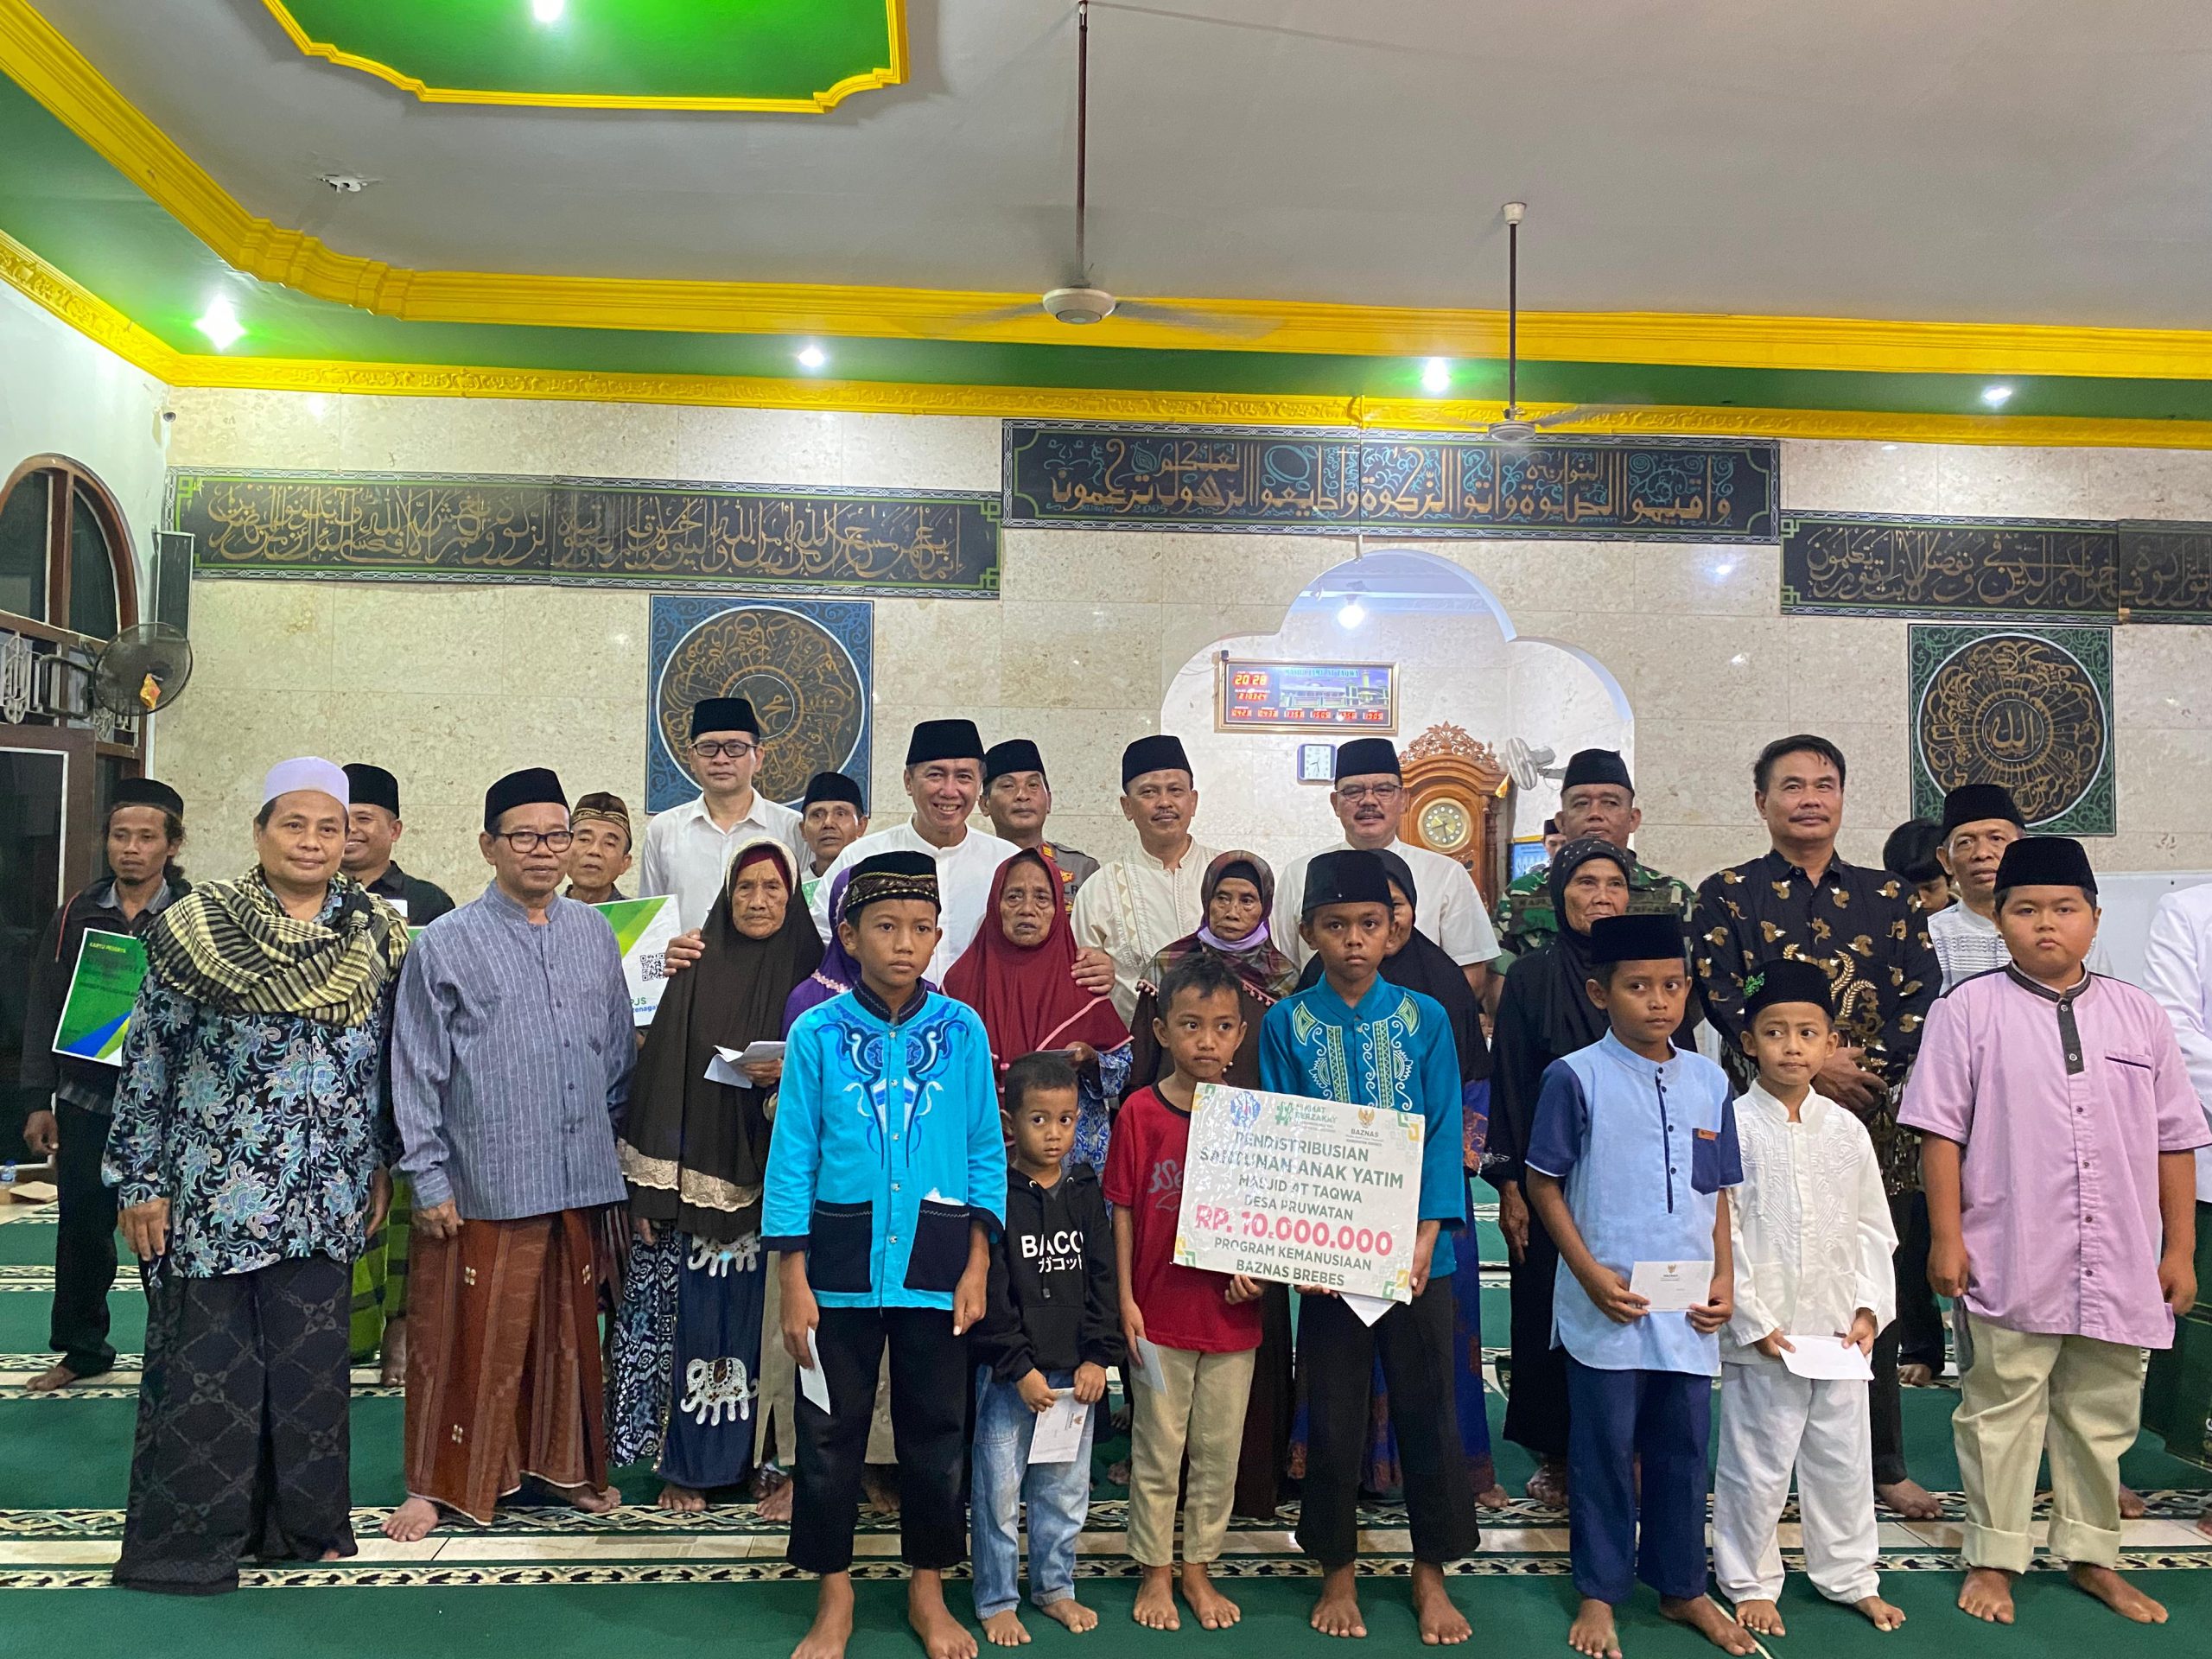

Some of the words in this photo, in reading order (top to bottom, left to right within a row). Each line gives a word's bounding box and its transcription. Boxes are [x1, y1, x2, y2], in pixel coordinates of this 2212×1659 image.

[1133, 503, 1168, 514] 2005
[1351, 1128, 1379, 1138] BAZNAS
[1238, 1173, 1287, 1192] MASJID
[1313, 1184, 1363, 1204] TAQWA
[1298, 1160, 1347, 1182] ANAK
[1352, 1166, 1403, 1190] YATIM
[1244, 1193, 1277, 1211] DESA
[1281, 1199, 1353, 1221] PRUWATAN
[1194, 1204, 1233, 1233] RP.
[1241, 1211, 1393, 1256] 10.000.000
[1214, 1236, 1275, 1256] PROGRAM
[1278, 1246, 1372, 1271] KEMANUSIAAN
[1236, 1259, 1290, 1278] BAZNAS
[1293, 1268, 1344, 1287] BREBES
